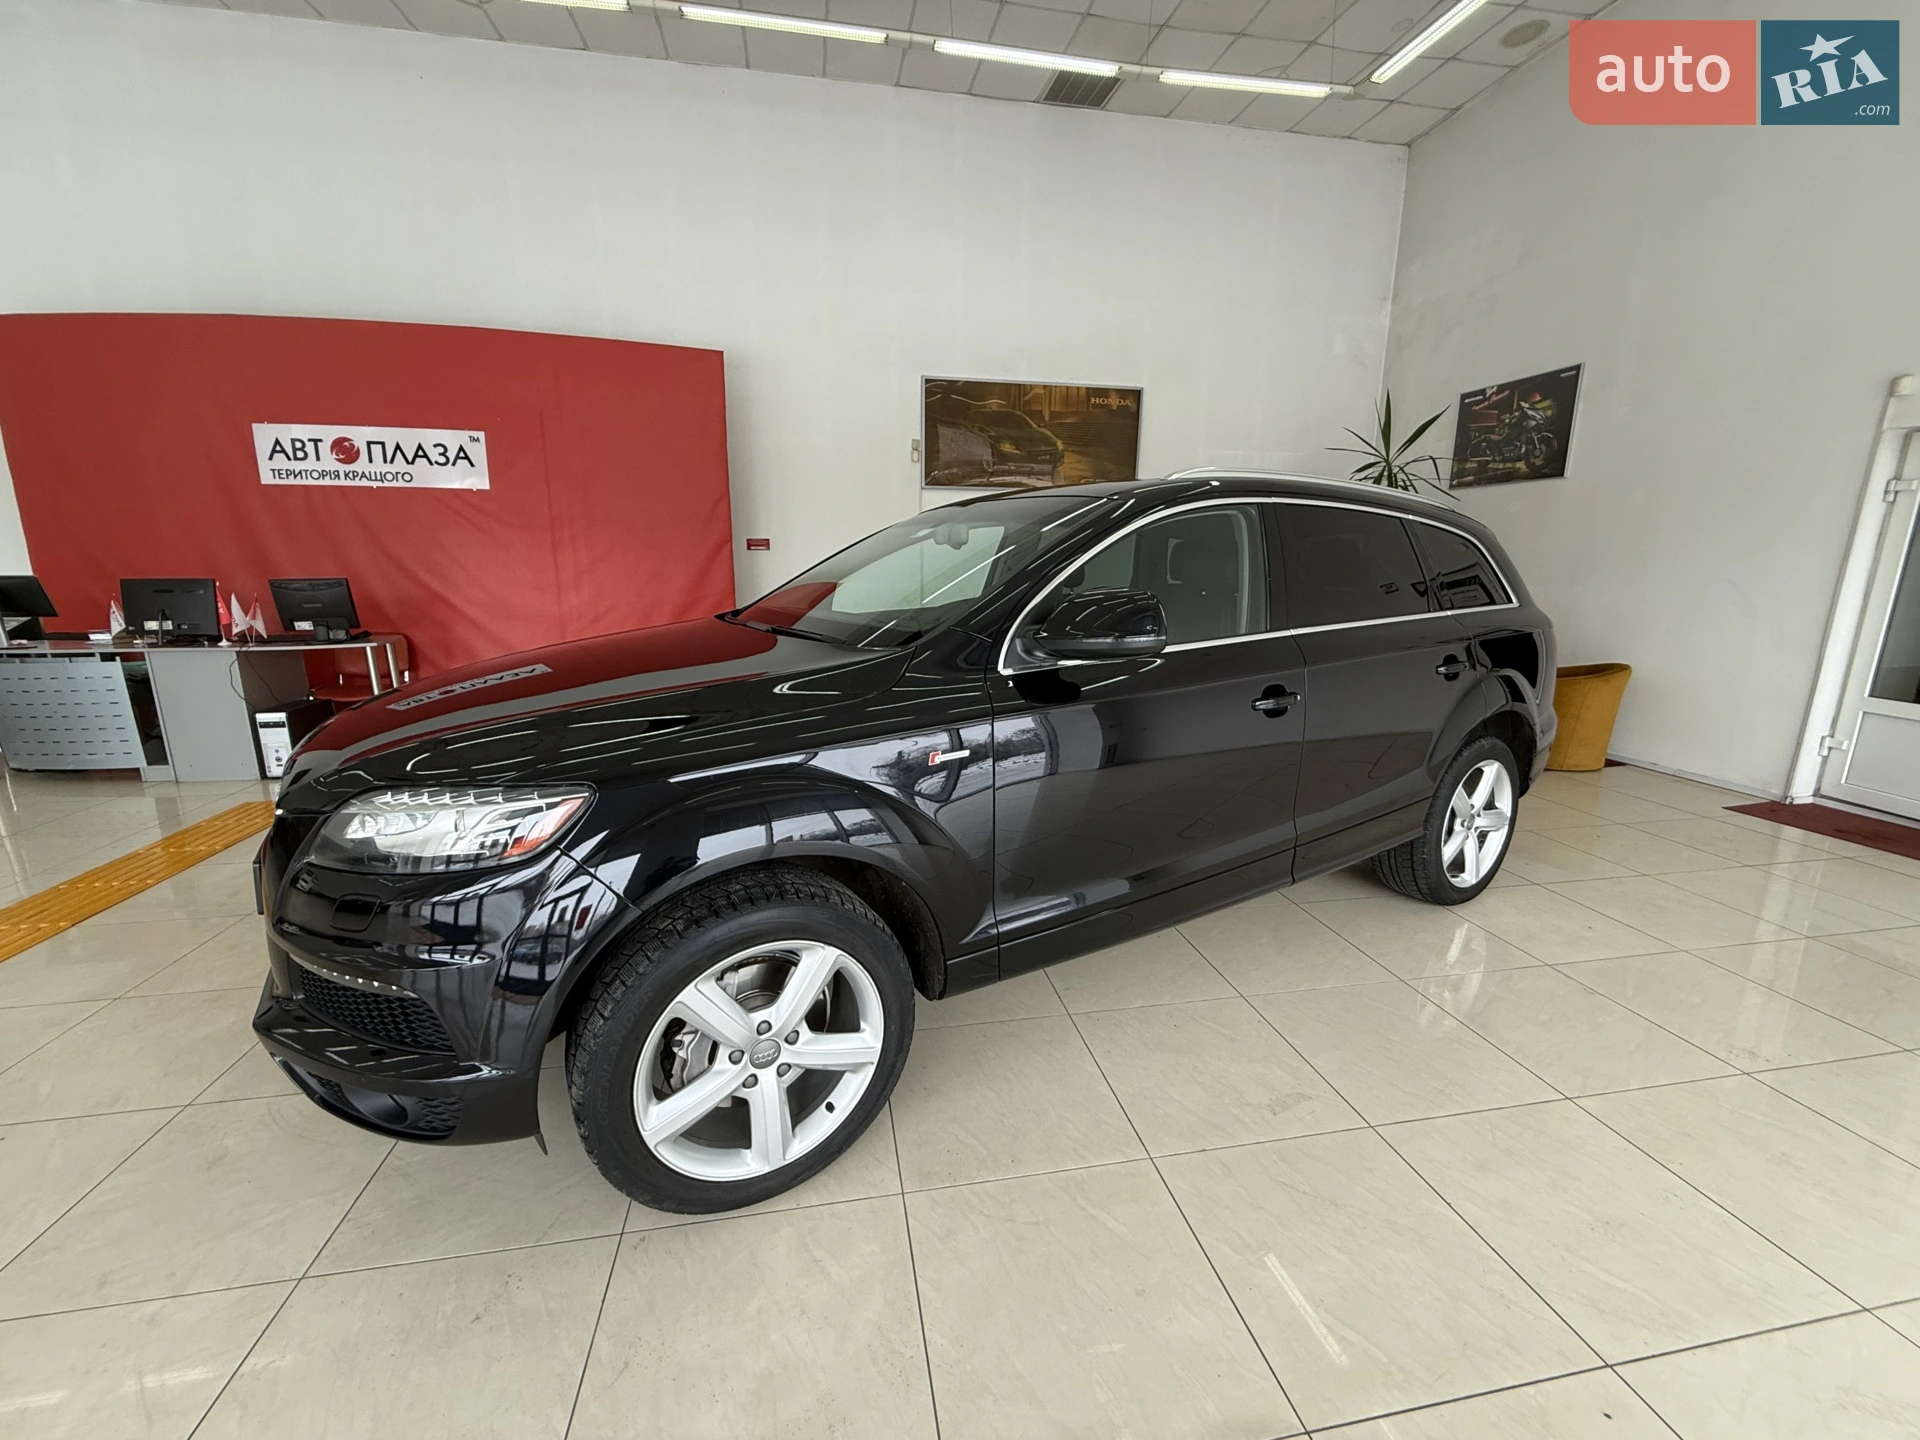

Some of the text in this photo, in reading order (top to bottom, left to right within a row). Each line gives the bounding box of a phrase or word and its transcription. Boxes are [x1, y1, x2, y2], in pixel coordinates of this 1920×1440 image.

[1091, 397, 1132, 406] HONDA
[269, 468, 414, 484] ТЕРИТОРІЯ КРАЩОГО
[598, 986, 654, 1126] GRENLANDER
